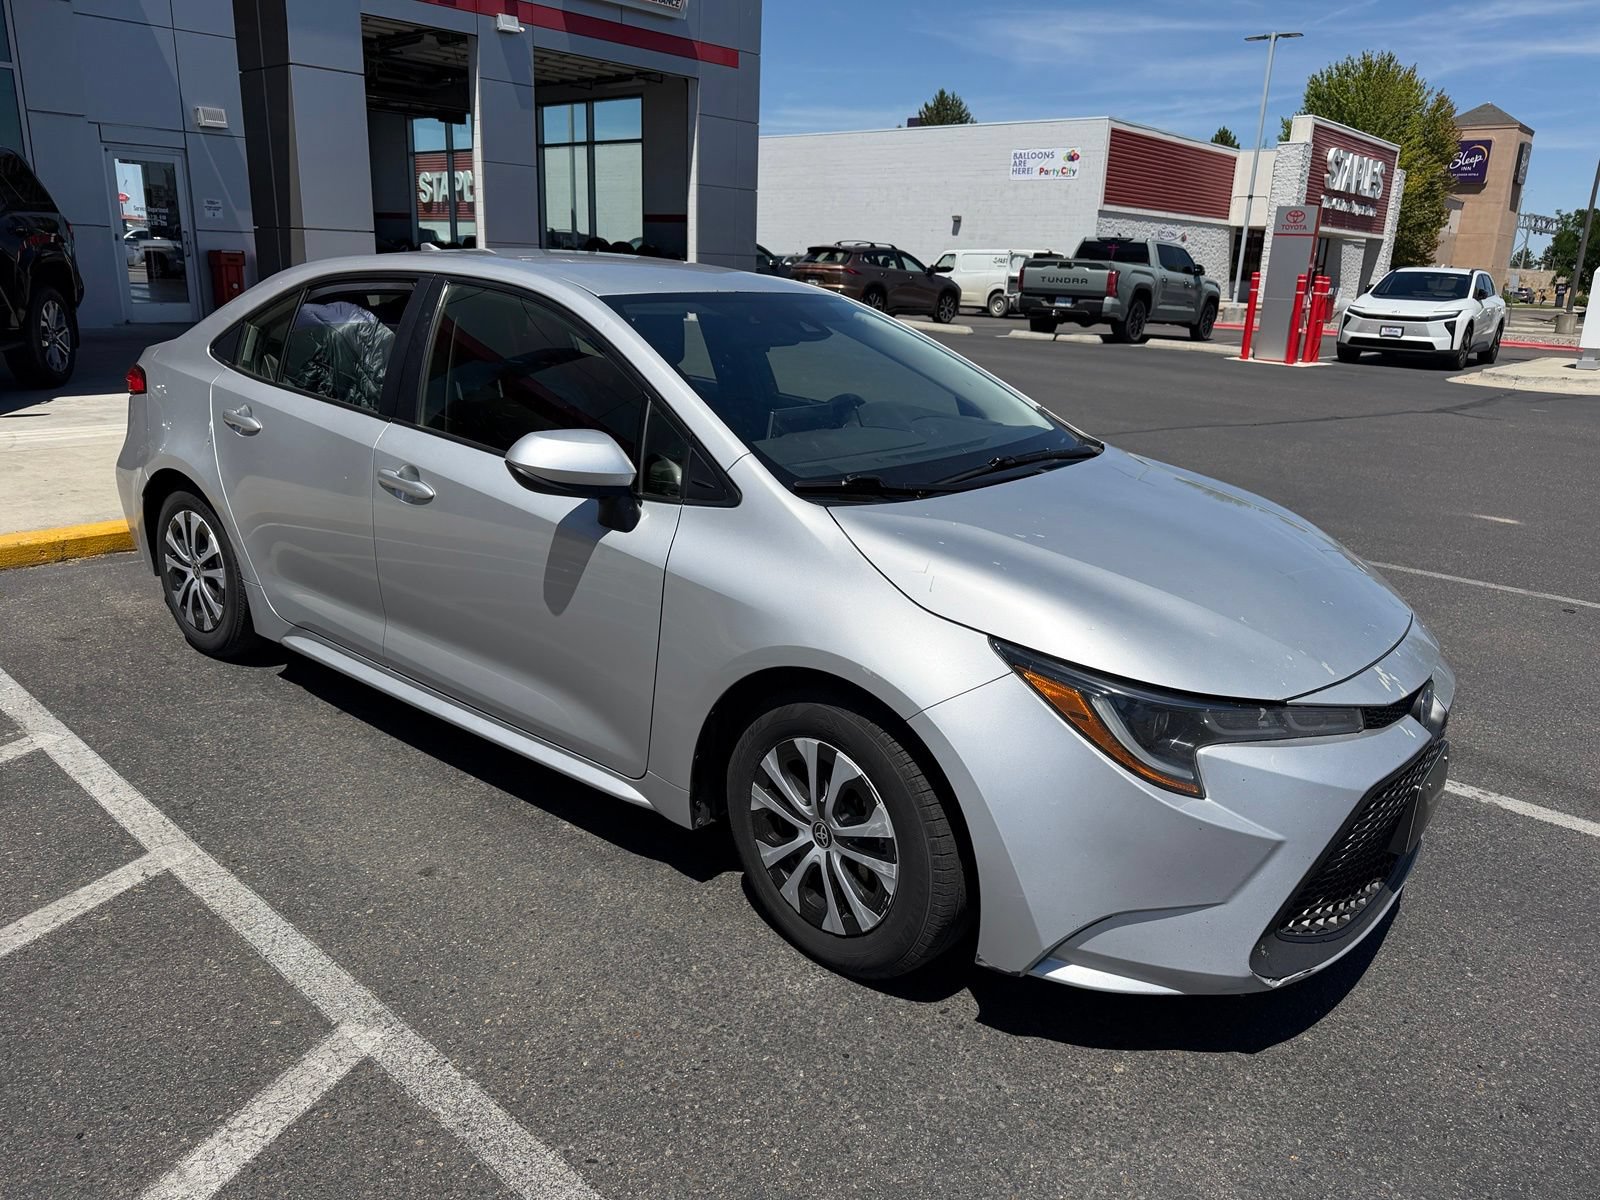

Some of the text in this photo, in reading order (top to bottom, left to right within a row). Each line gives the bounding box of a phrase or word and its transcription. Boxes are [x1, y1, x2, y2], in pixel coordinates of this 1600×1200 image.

[1012, 151, 1055, 160] BALLOONS
[1449, 150, 1484, 170] Sleep
[1011, 167, 1033, 175] HERE!
[1039, 166, 1077, 177] Party City
[1324, 147, 1386, 200] STAPLES
[418, 170, 474, 203] STAPL
[1040, 276, 1088, 285] TUNDRA
